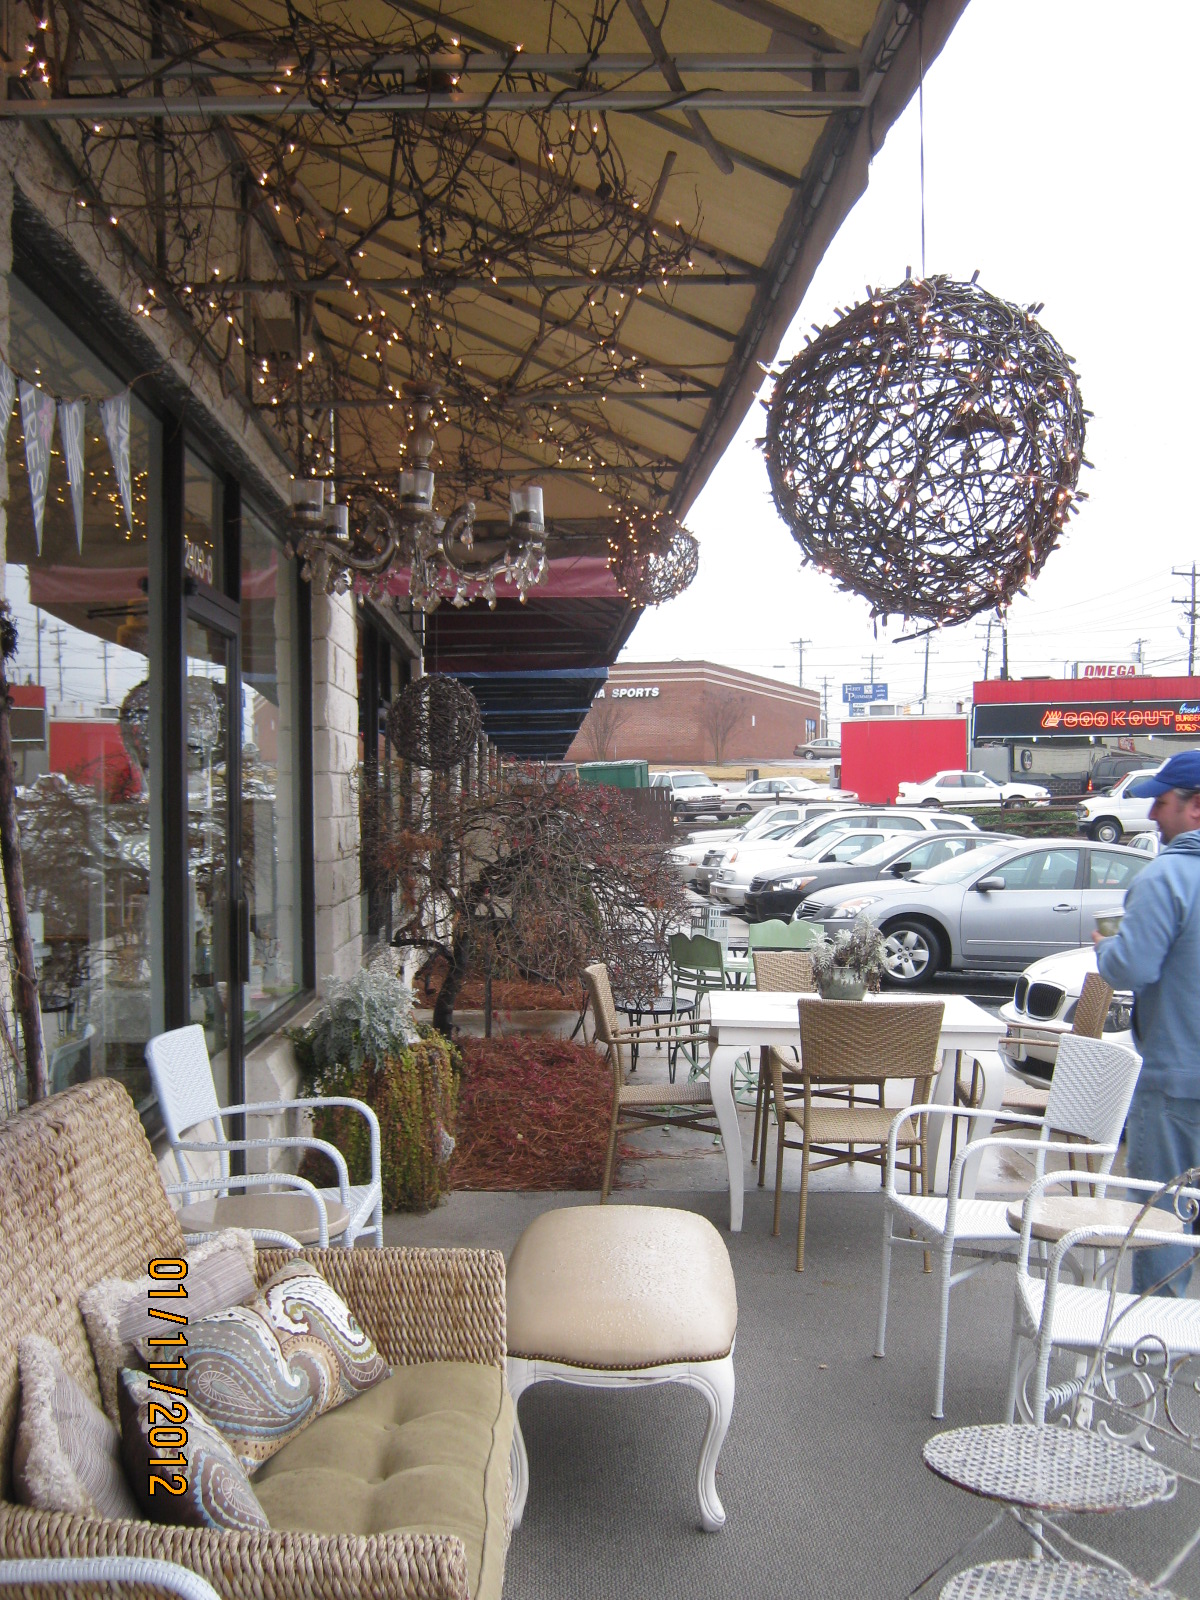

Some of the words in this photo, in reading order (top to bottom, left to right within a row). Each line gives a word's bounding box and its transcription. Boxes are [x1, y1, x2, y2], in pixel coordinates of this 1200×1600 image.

[21, 388, 44, 526] FRESH
[1084, 665, 1136, 676] OMEGA
[611, 687, 660, 698] SPORTS
[1175, 723, 1197, 732] DOGS
